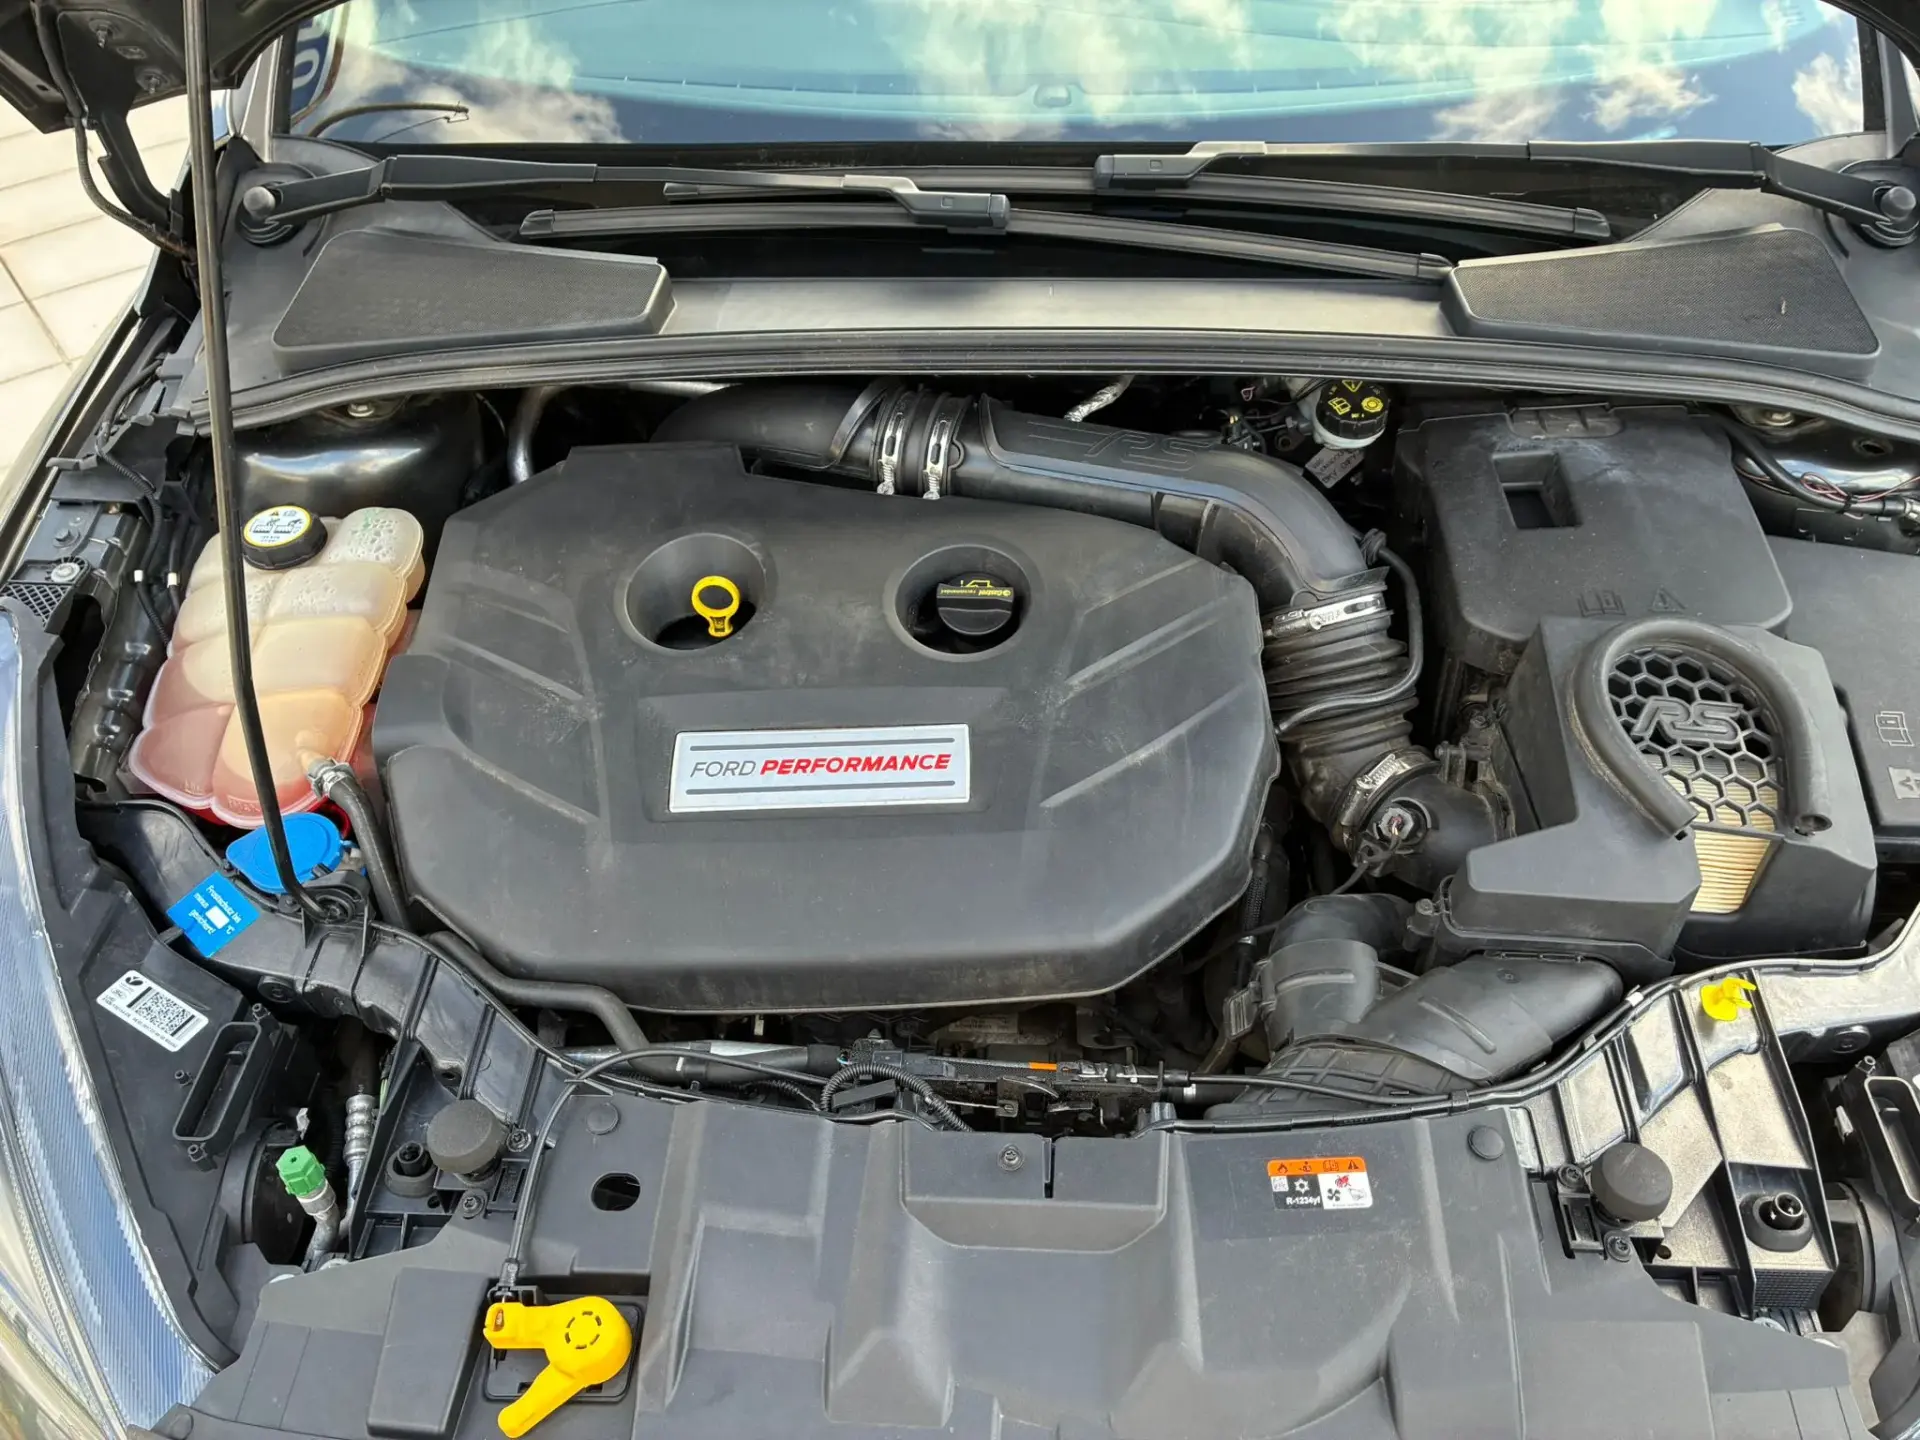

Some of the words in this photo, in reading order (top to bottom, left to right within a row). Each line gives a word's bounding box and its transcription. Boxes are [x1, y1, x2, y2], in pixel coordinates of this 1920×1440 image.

[1084, 429, 1220, 472] RS
[1630, 695, 1744, 746] RS
[690, 760, 756, 778] FORD
[759, 753, 952, 776] PERFORMANCE
[193, 892, 209, 909] minus
[206, 884, 235, 916] Frostschutz
[231, 911, 242, 924] bis
[1286, 1195, 1321, 1206] R-1234yf
